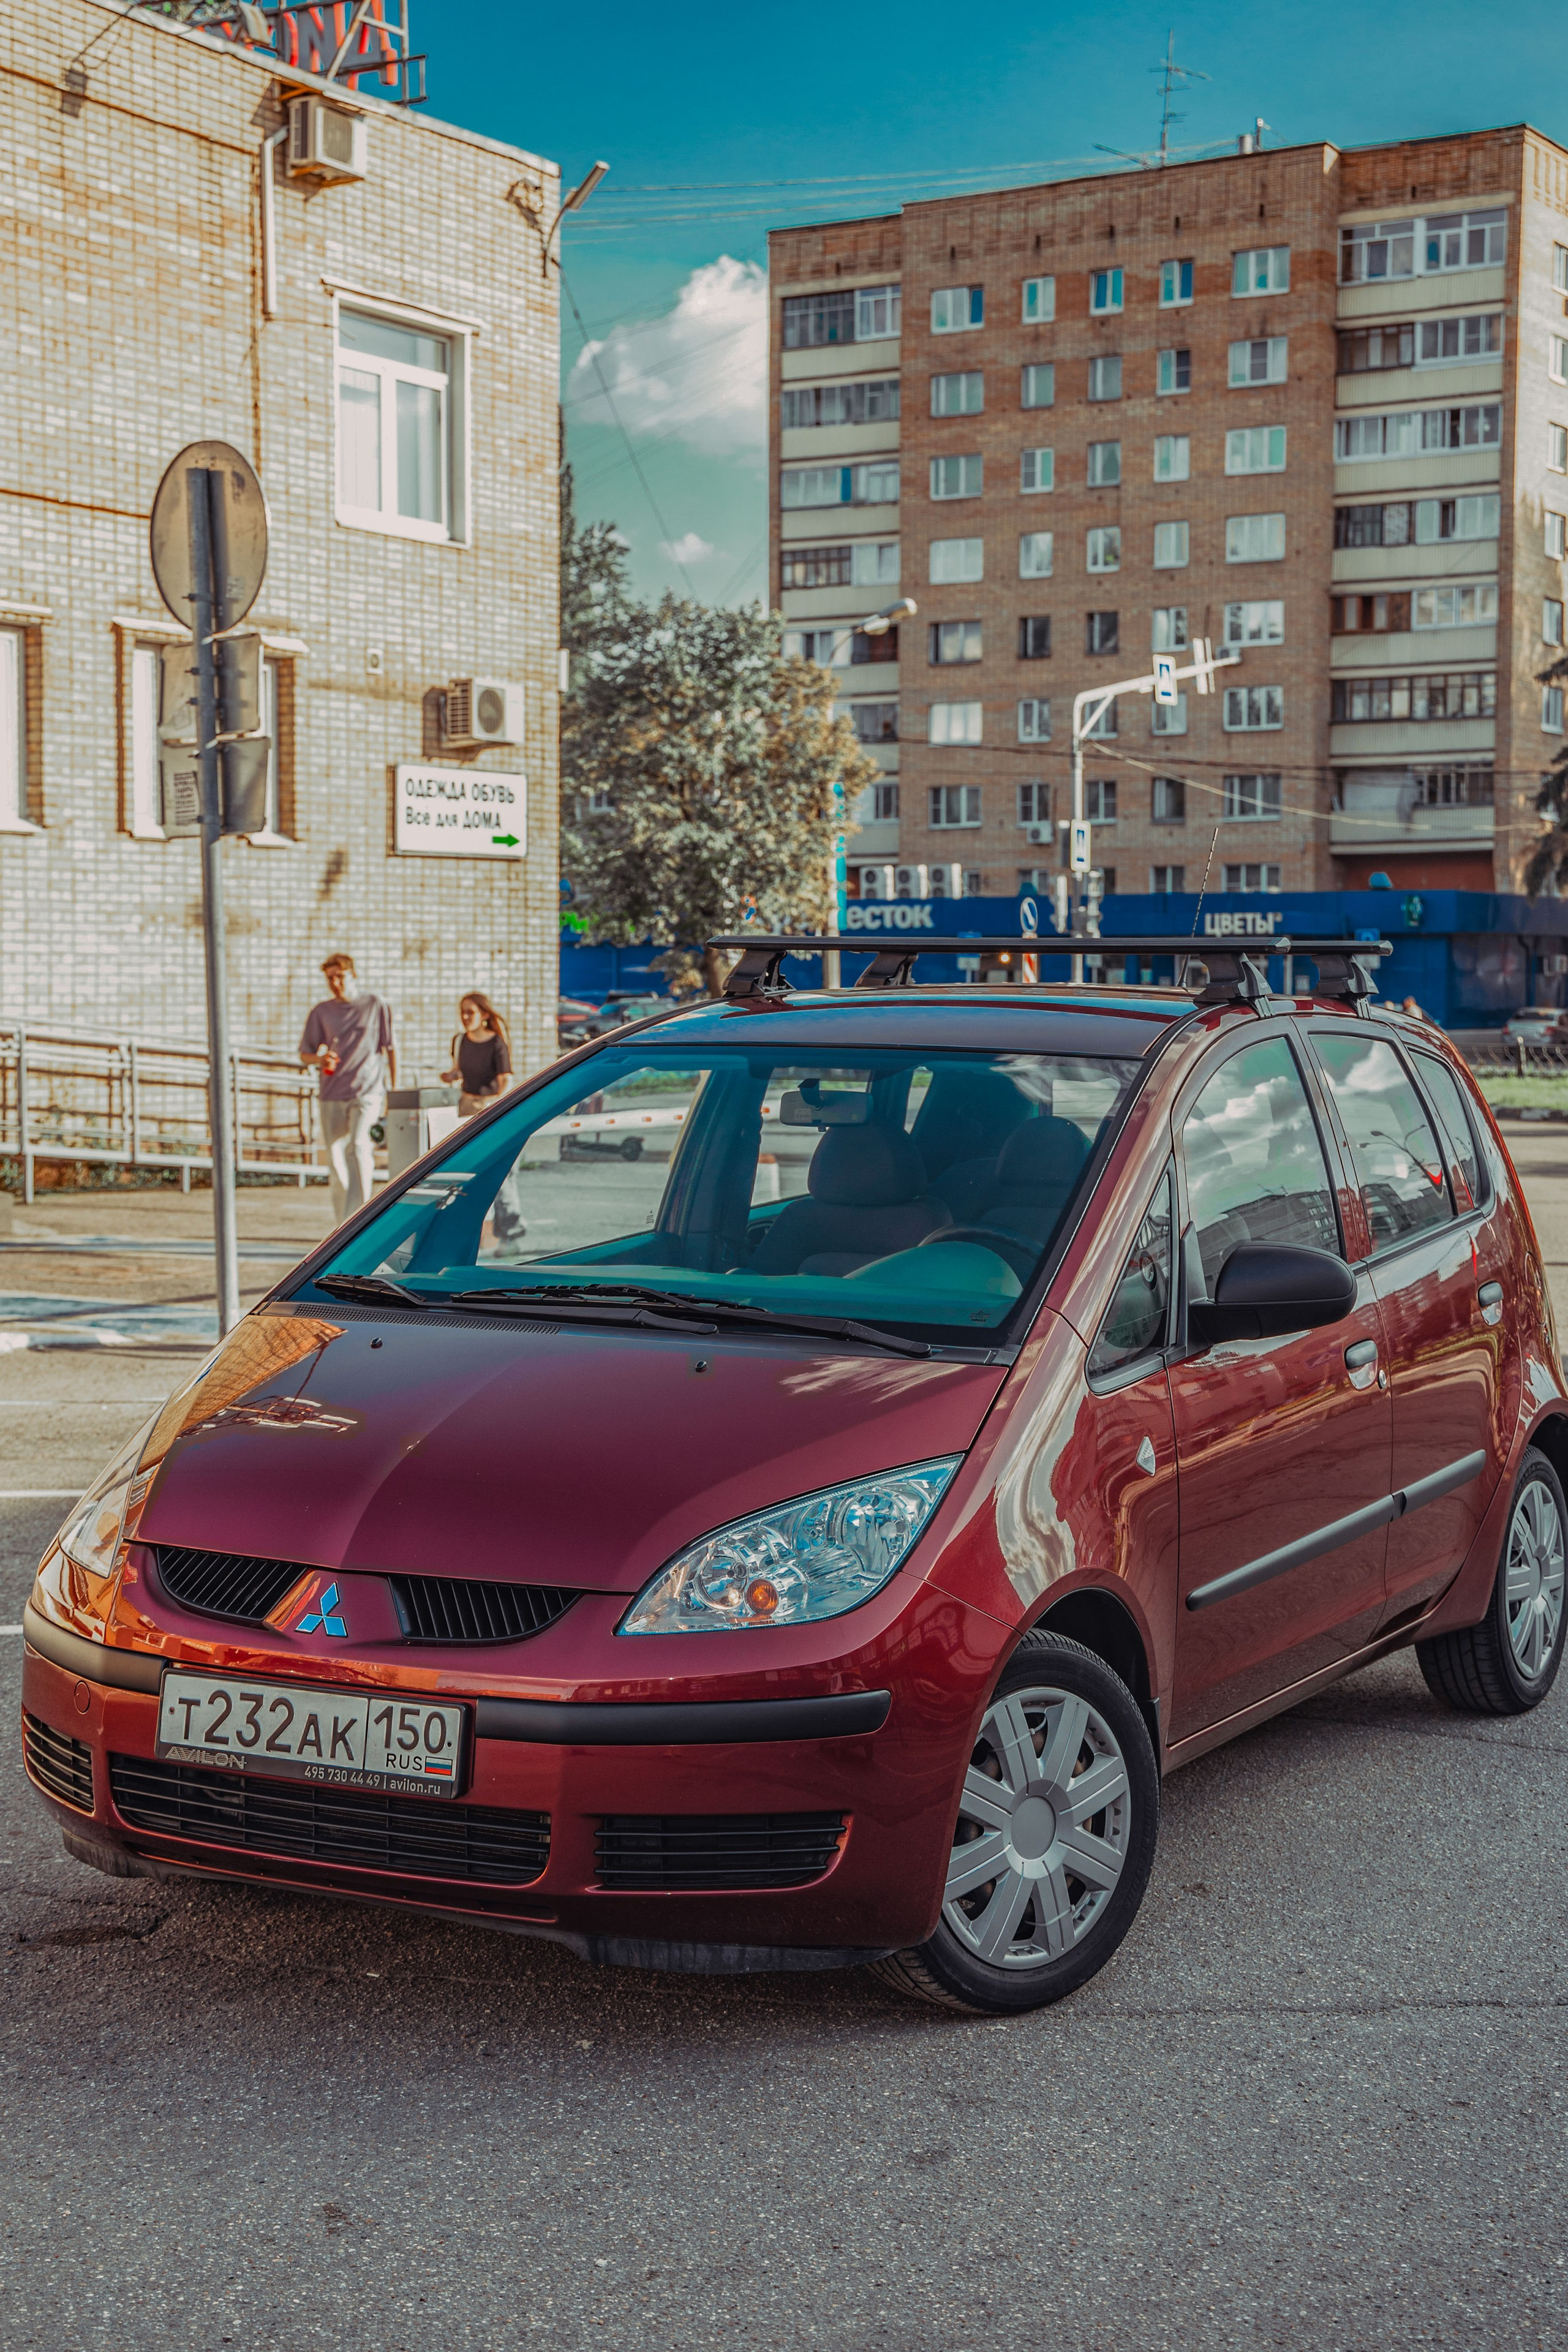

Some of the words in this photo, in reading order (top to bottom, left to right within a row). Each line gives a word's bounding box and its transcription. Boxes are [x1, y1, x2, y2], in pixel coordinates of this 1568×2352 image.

[405, 778, 466, 800] ОДЕЖДА
[471, 783, 514, 804] ОБУВЬ
[435, 813, 458, 827] для
[462, 810, 502, 829] ДОМА
[846, 904, 934, 930] есток
[1204, 911, 1275, 938] ЦВЕТЫ
[373, 1705, 448, 1754] 150
[165, 1746, 247, 1769] AVILON
[385, 1753, 423, 1772] RUS
[304, 1765, 325, 1780] 495
[328, 1768, 348, 1782] 730
[350, 1771, 364, 1785] 44
[366, 1774, 380, 1787] 49
[390, 1779, 441, 1795] avilon.ru
